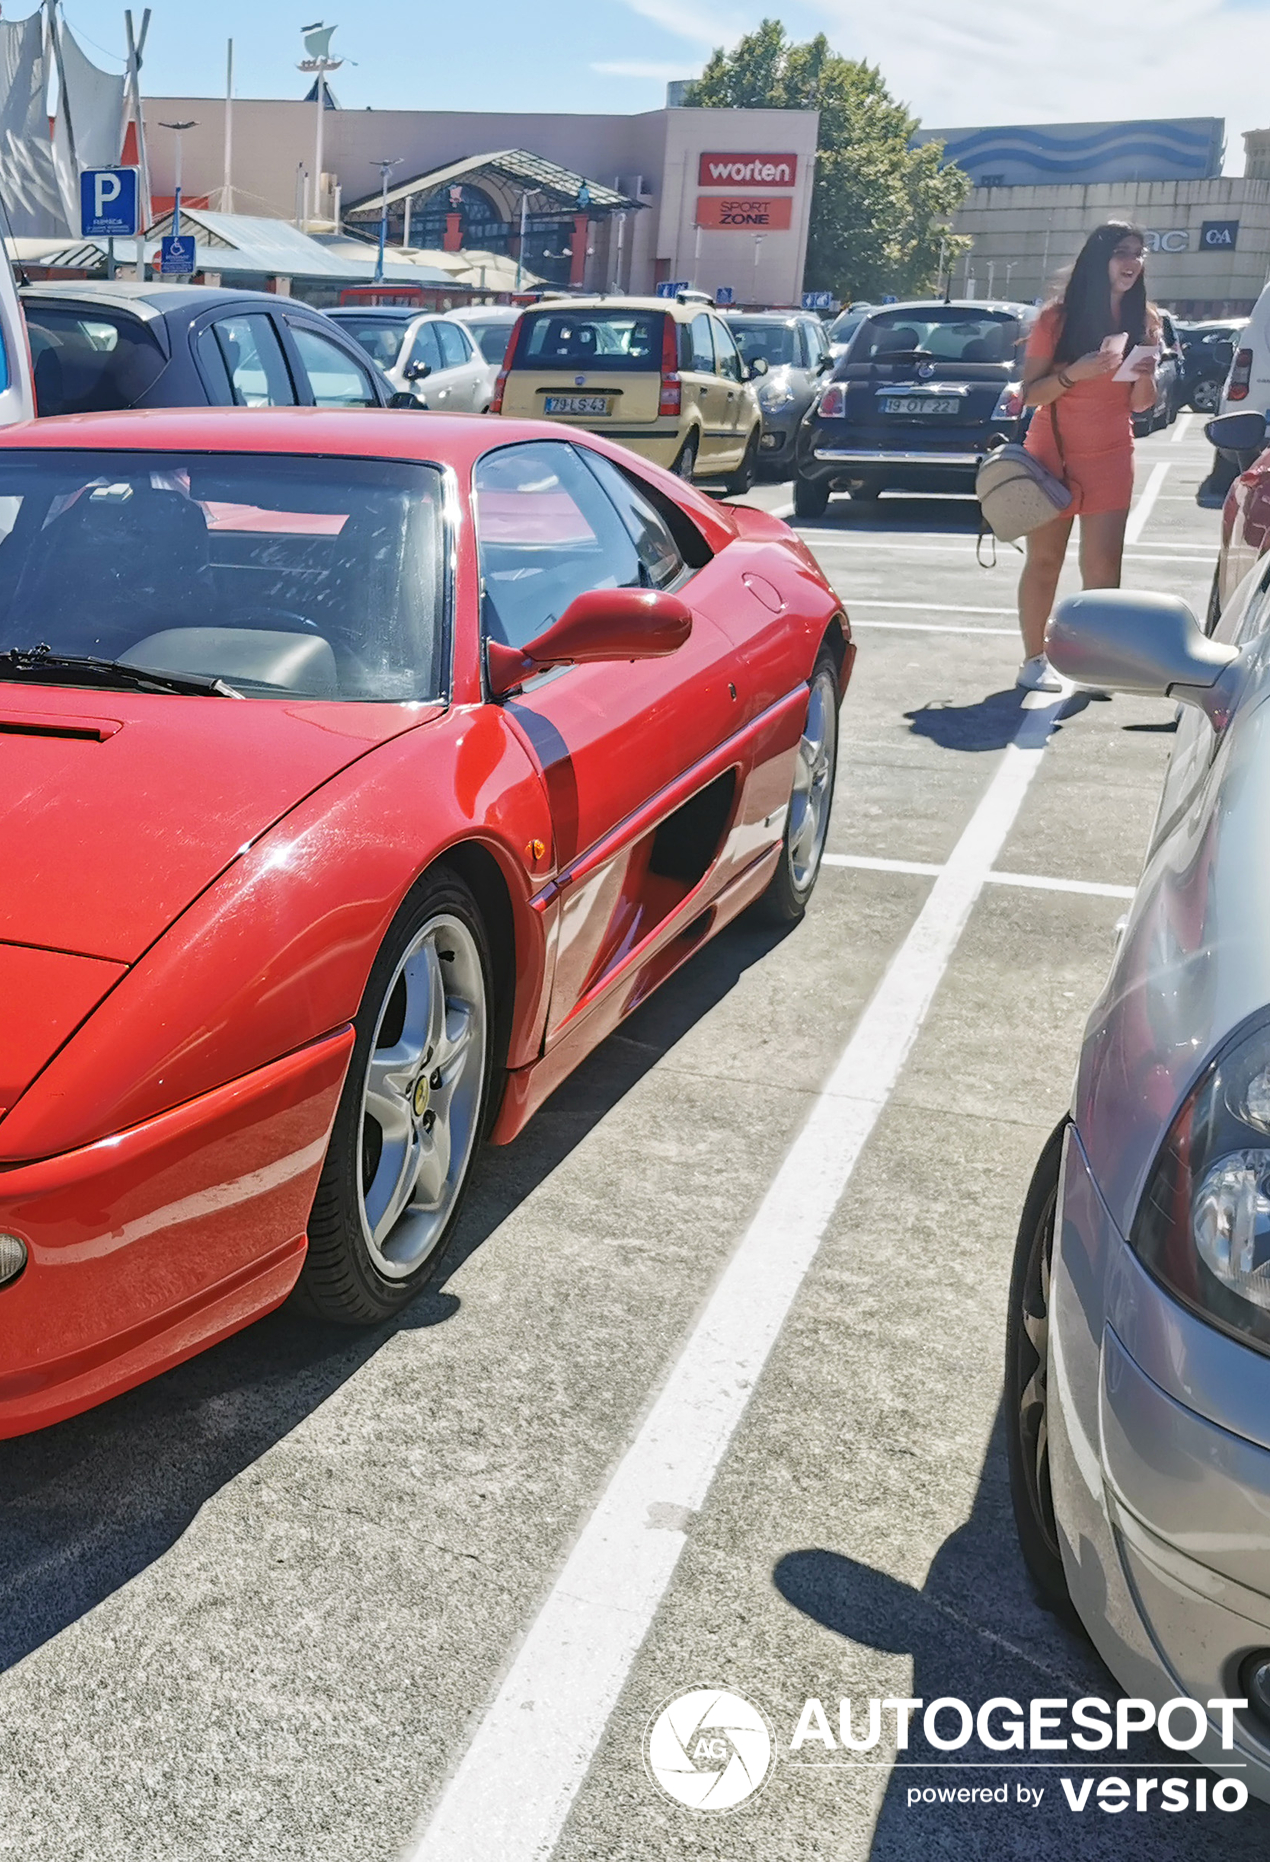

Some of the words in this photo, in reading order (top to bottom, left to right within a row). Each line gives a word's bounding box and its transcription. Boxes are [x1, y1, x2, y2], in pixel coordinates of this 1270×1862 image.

[709, 159, 790, 182] worten
[94, 172, 122, 218] P
[719, 201, 771, 213] SPORT
[718, 213, 770, 225] ZONE
[1144, 229, 1189, 252] ac
